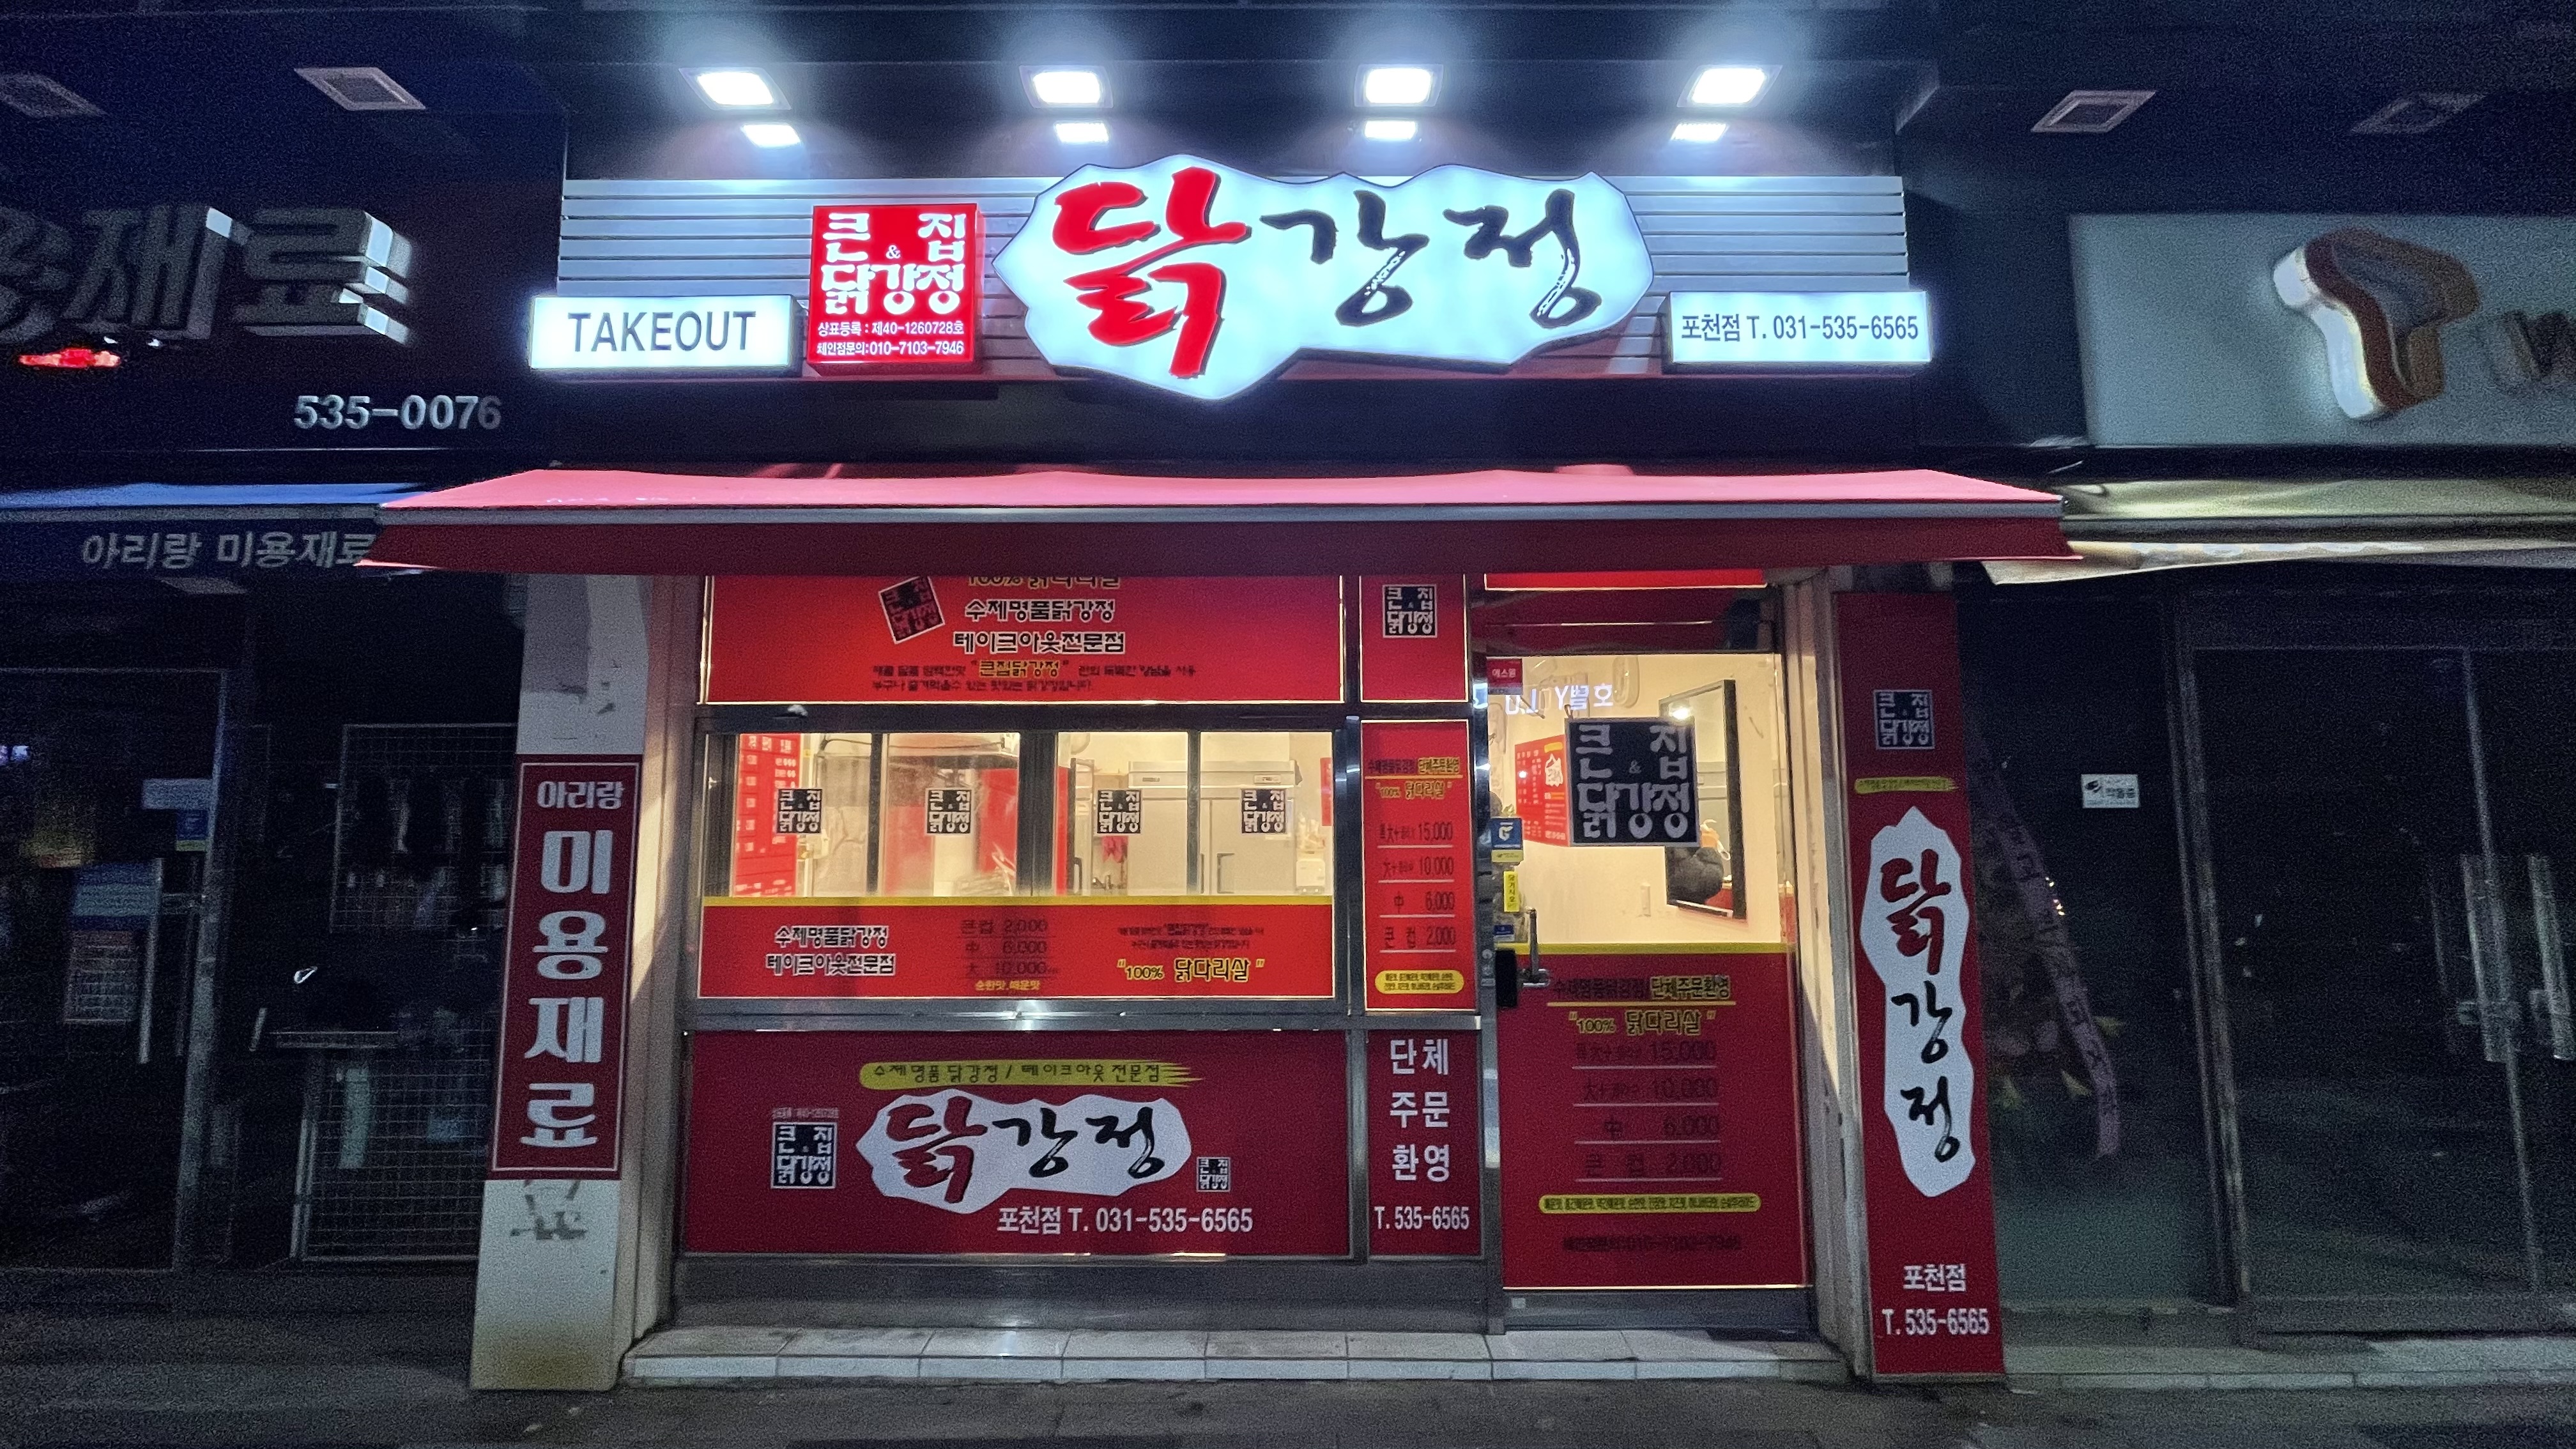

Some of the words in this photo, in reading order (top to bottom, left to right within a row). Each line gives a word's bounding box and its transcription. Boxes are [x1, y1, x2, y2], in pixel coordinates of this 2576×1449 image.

[823, 212, 870, 262] 큰
[918, 213, 966, 262] 집
[1052, 167, 1602, 378] 닭강정
[820, 263, 965, 315] 닭강정
[568, 310, 756, 352] TAKEOUT
[817, 321, 862, 337] 상표등록
[871, 321, 965, 337] 제40-1260728호
[1681, 312, 1741, 342] 포천점
[1747, 315, 1767, 339] T.
[1773, 315, 1919, 340] 031-535-6565
[294, 394, 502, 430] 535-0076
[82, 533, 202, 569] 아리랑
[217, 533, 378, 568] 미용재료
[965, 599, 1116, 623] 수제명품닭강정
[1386, 610, 1434, 634] 닭강정
[953, 631, 1126, 654] 테이크아웃전문점
[1575, 724, 1613, 779] 큰
[1649, 724, 1688, 781] 집
[536, 780, 625, 810] 아리랑
[779, 811, 821, 832] 닭강정
[929, 811, 970, 833] 닭강정
[1098, 811, 1140, 833] 닭강정
[1243, 810, 1285, 832] 닭강정
[1576, 782, 1690, 839] 닭강정
[773, 924, 890, 950] 수제명품닭강정
[765, 953, 896, 977] 테이크아웃전문점
[519, 829, 614, 1148] 미용재료
[1880, 848, 1961, 1163] 닭강정
[1390, 1038, 1449, 1075] 단체
[1389, 1091, 1450, 1128] 주문
[887, 1095, 1165, 1204] 닭강정
[1392, 1144, 1450, 1183] 환영
[776, 1155, 831, 1185] 닭강정
[997, 1206, 1062, 1235] 포천점
[1068, 1207, 1089, 1232] T.
[1096, 1206, 1254, 1234] 031-535-6565
[1374, 1206, 1391, 1230] T.
[1394, 1205, 1470, 1230] 535-6565
[1903, 1263, 1966, 1292] 포천점
[1882, 1308, 1901, 1335] T.
[1905, 1307, 1990, 1336] 535-6565
